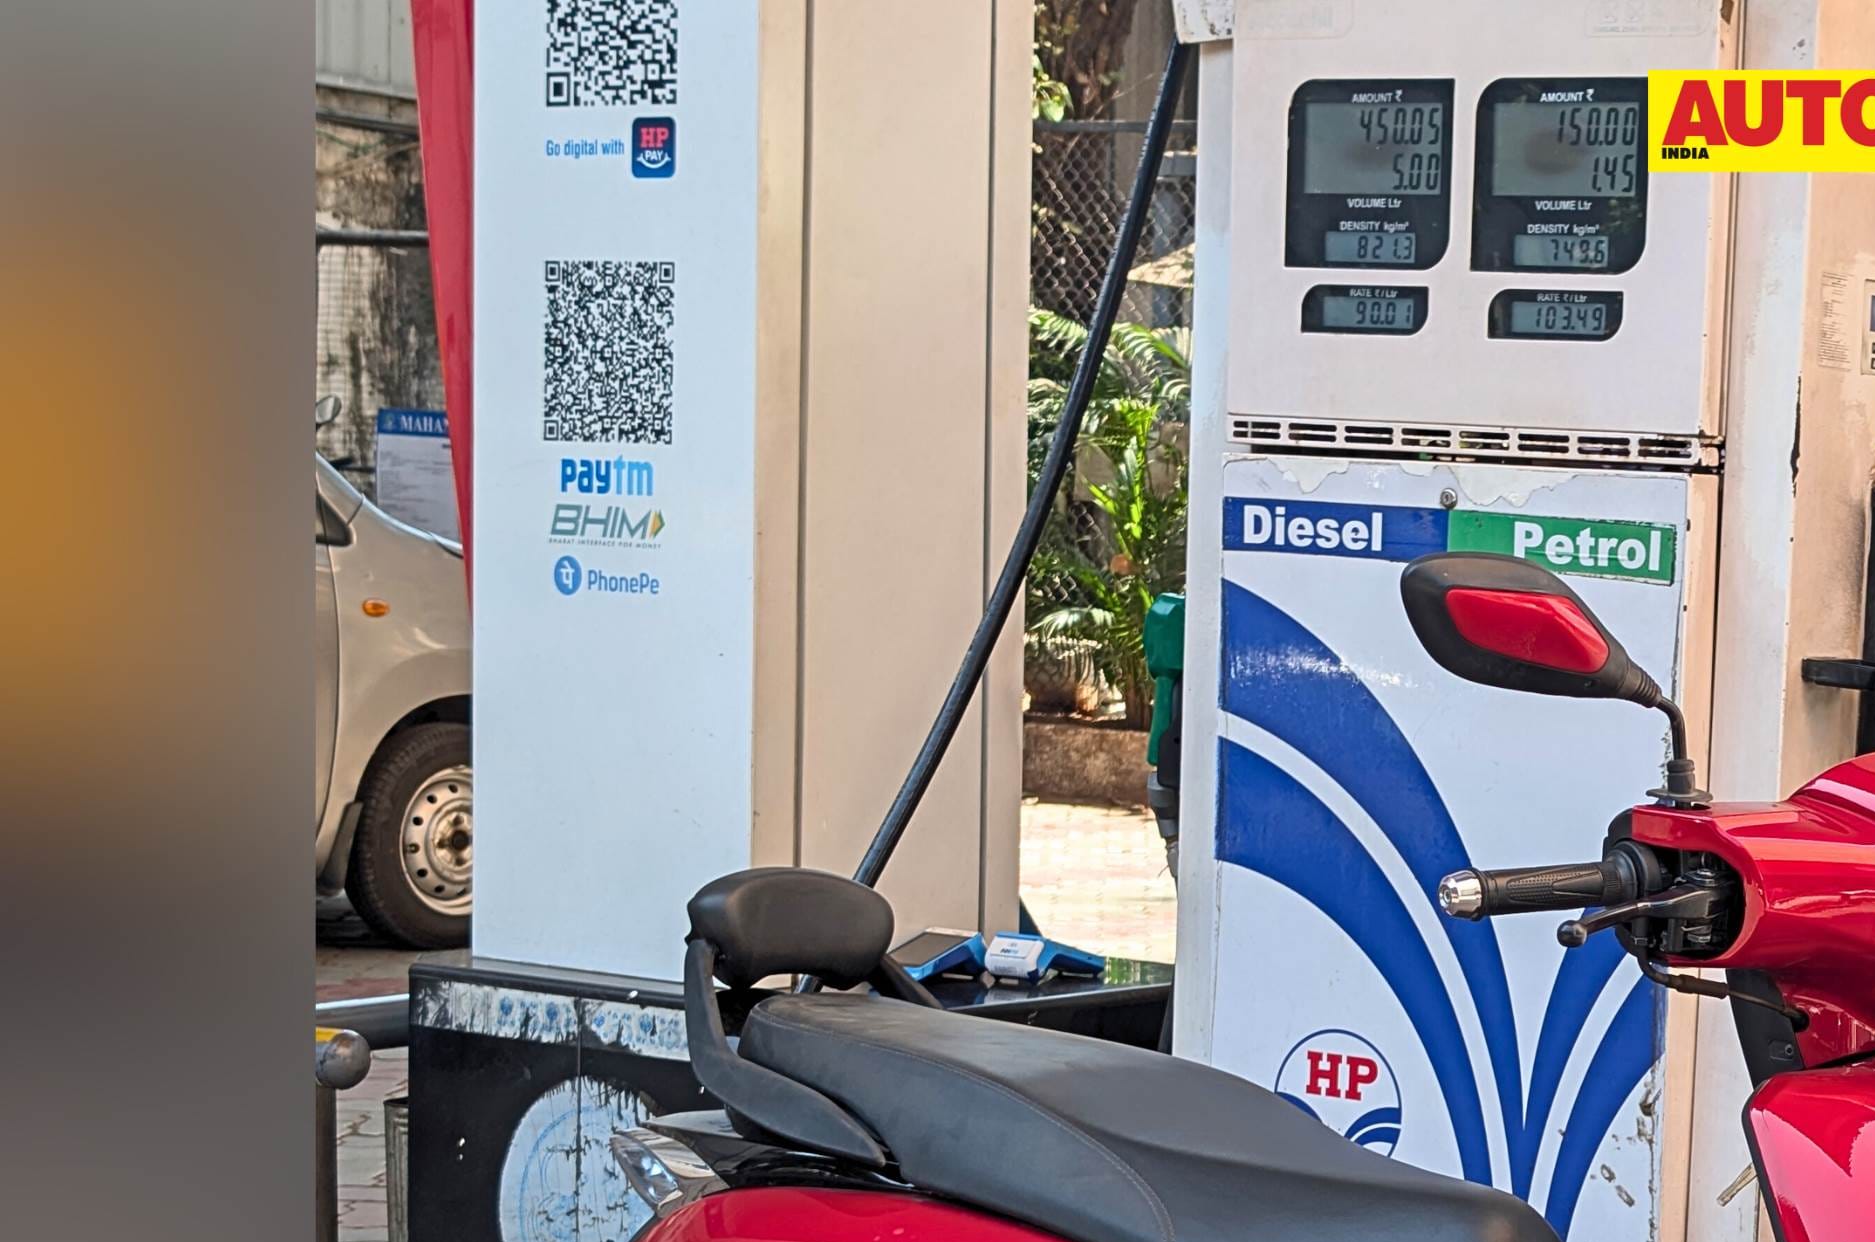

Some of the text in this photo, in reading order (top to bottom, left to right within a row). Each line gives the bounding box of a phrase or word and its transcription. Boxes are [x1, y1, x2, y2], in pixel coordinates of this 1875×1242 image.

[1351, 93, 1393, 103] AMOUNT
[1540, 92, 1584, 102] AMOUNT
[640, 127, 669, 148] HP
[1360, 107, 1440, 145] 450.05
[1557, 107, 1637, 146] 150.00
[546, 139, 624, 159] Go digital with
[645, 150, 662, 160] PAY
[1392, 153, 1440, 190] 5.00
[1592, 154, 1634, 192] 1.45
[1347, 198, 1386, 208] VOLUME
[1535, 201, 1576, 210] VOLUME
[1340, 221, 1380, 231] DENSITY
[1527, 224, 1569, 234] DENSITY
[1350, 289, 1371, 297] RATE
[1537, 293, 1560, 302] RATE
[1356, 301, 1411, 325] 90.01
[1536, 306, 1603, 331] 103.49
[561, 455, 653, 496] paytm
[551, 504, 652, 539] BHIM
[1243, 505, 1383, 551] Diesel
[1513, 522, 1661, 571] Petrol
[588, 569, 660, 594] PhonePe
[1306, 1051, 1378, 1100] HP
